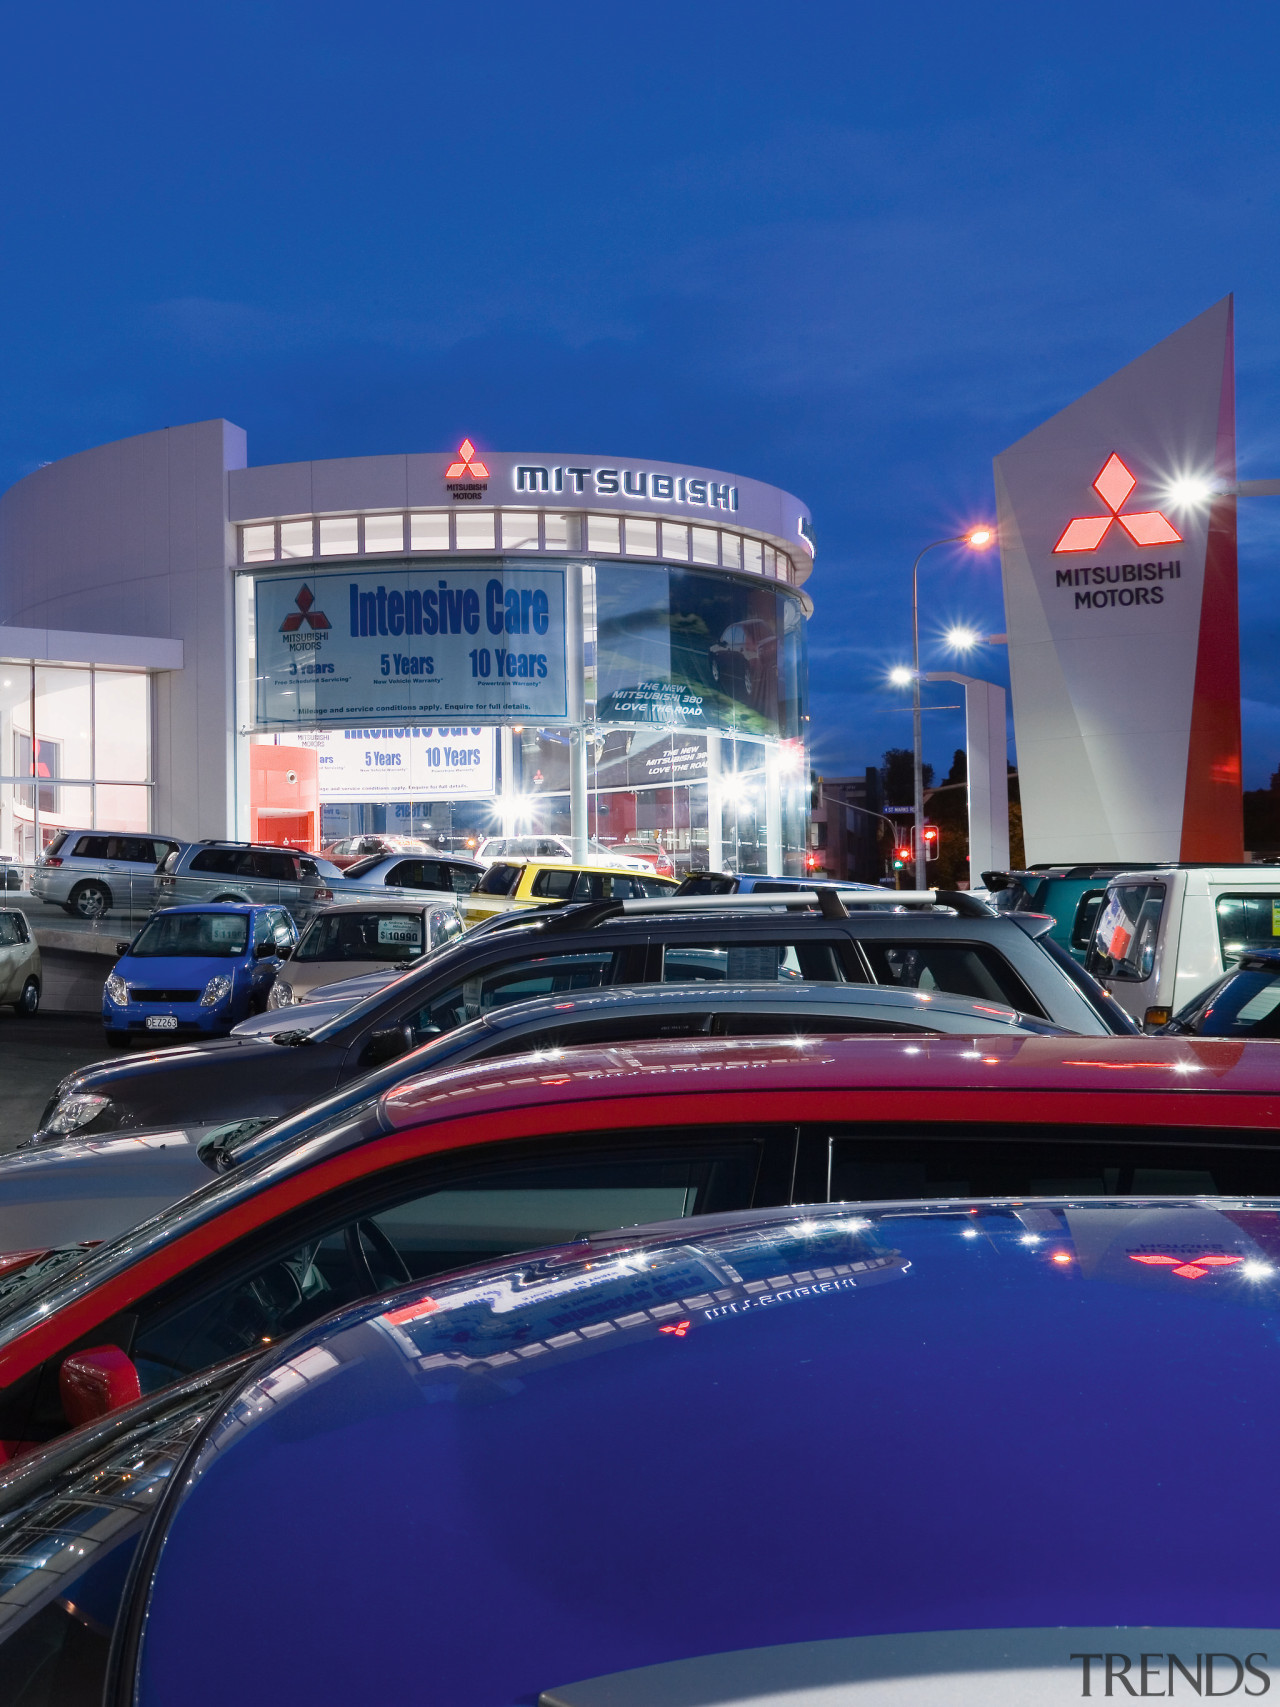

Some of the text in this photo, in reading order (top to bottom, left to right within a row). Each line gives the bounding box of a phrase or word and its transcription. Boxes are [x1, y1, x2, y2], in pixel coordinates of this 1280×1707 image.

[446, 483, 488, 491] MITSUBISHI
[515, 464, 739, 512] MITSUBISHI
[452, 492, 482, 500] MOTORS
[1055, 560, 1181, 588] MITSUBISHI
[1074, 586, 1164, 609] MOTORS
[349, 578, 549, 637] Intensive Care
[282, 632, 328, 643] MITSUBISHI
[289, 642, 322, 652] MOTORS
[380, 653, 434, 676] 5 Years
[469, 648, 548, 678] 10 Years
[637, 682, 687, 693] THE NEW
[612, 690, 704, 704] MITSUBISHI 380
[330, 706, 344, 714] and
[444, 703, 473, 711] Enquire
[614, 702, 703, 716] LOVE THE ROAD
[320, 756, 334, 764] ars
[365, 752, 401, 766] 5 Years
[425, 747, 481, 767] 10 Years
[648, 766, 671, 774] LOVE
[146, 1017, 177, 1029] DEZ263
